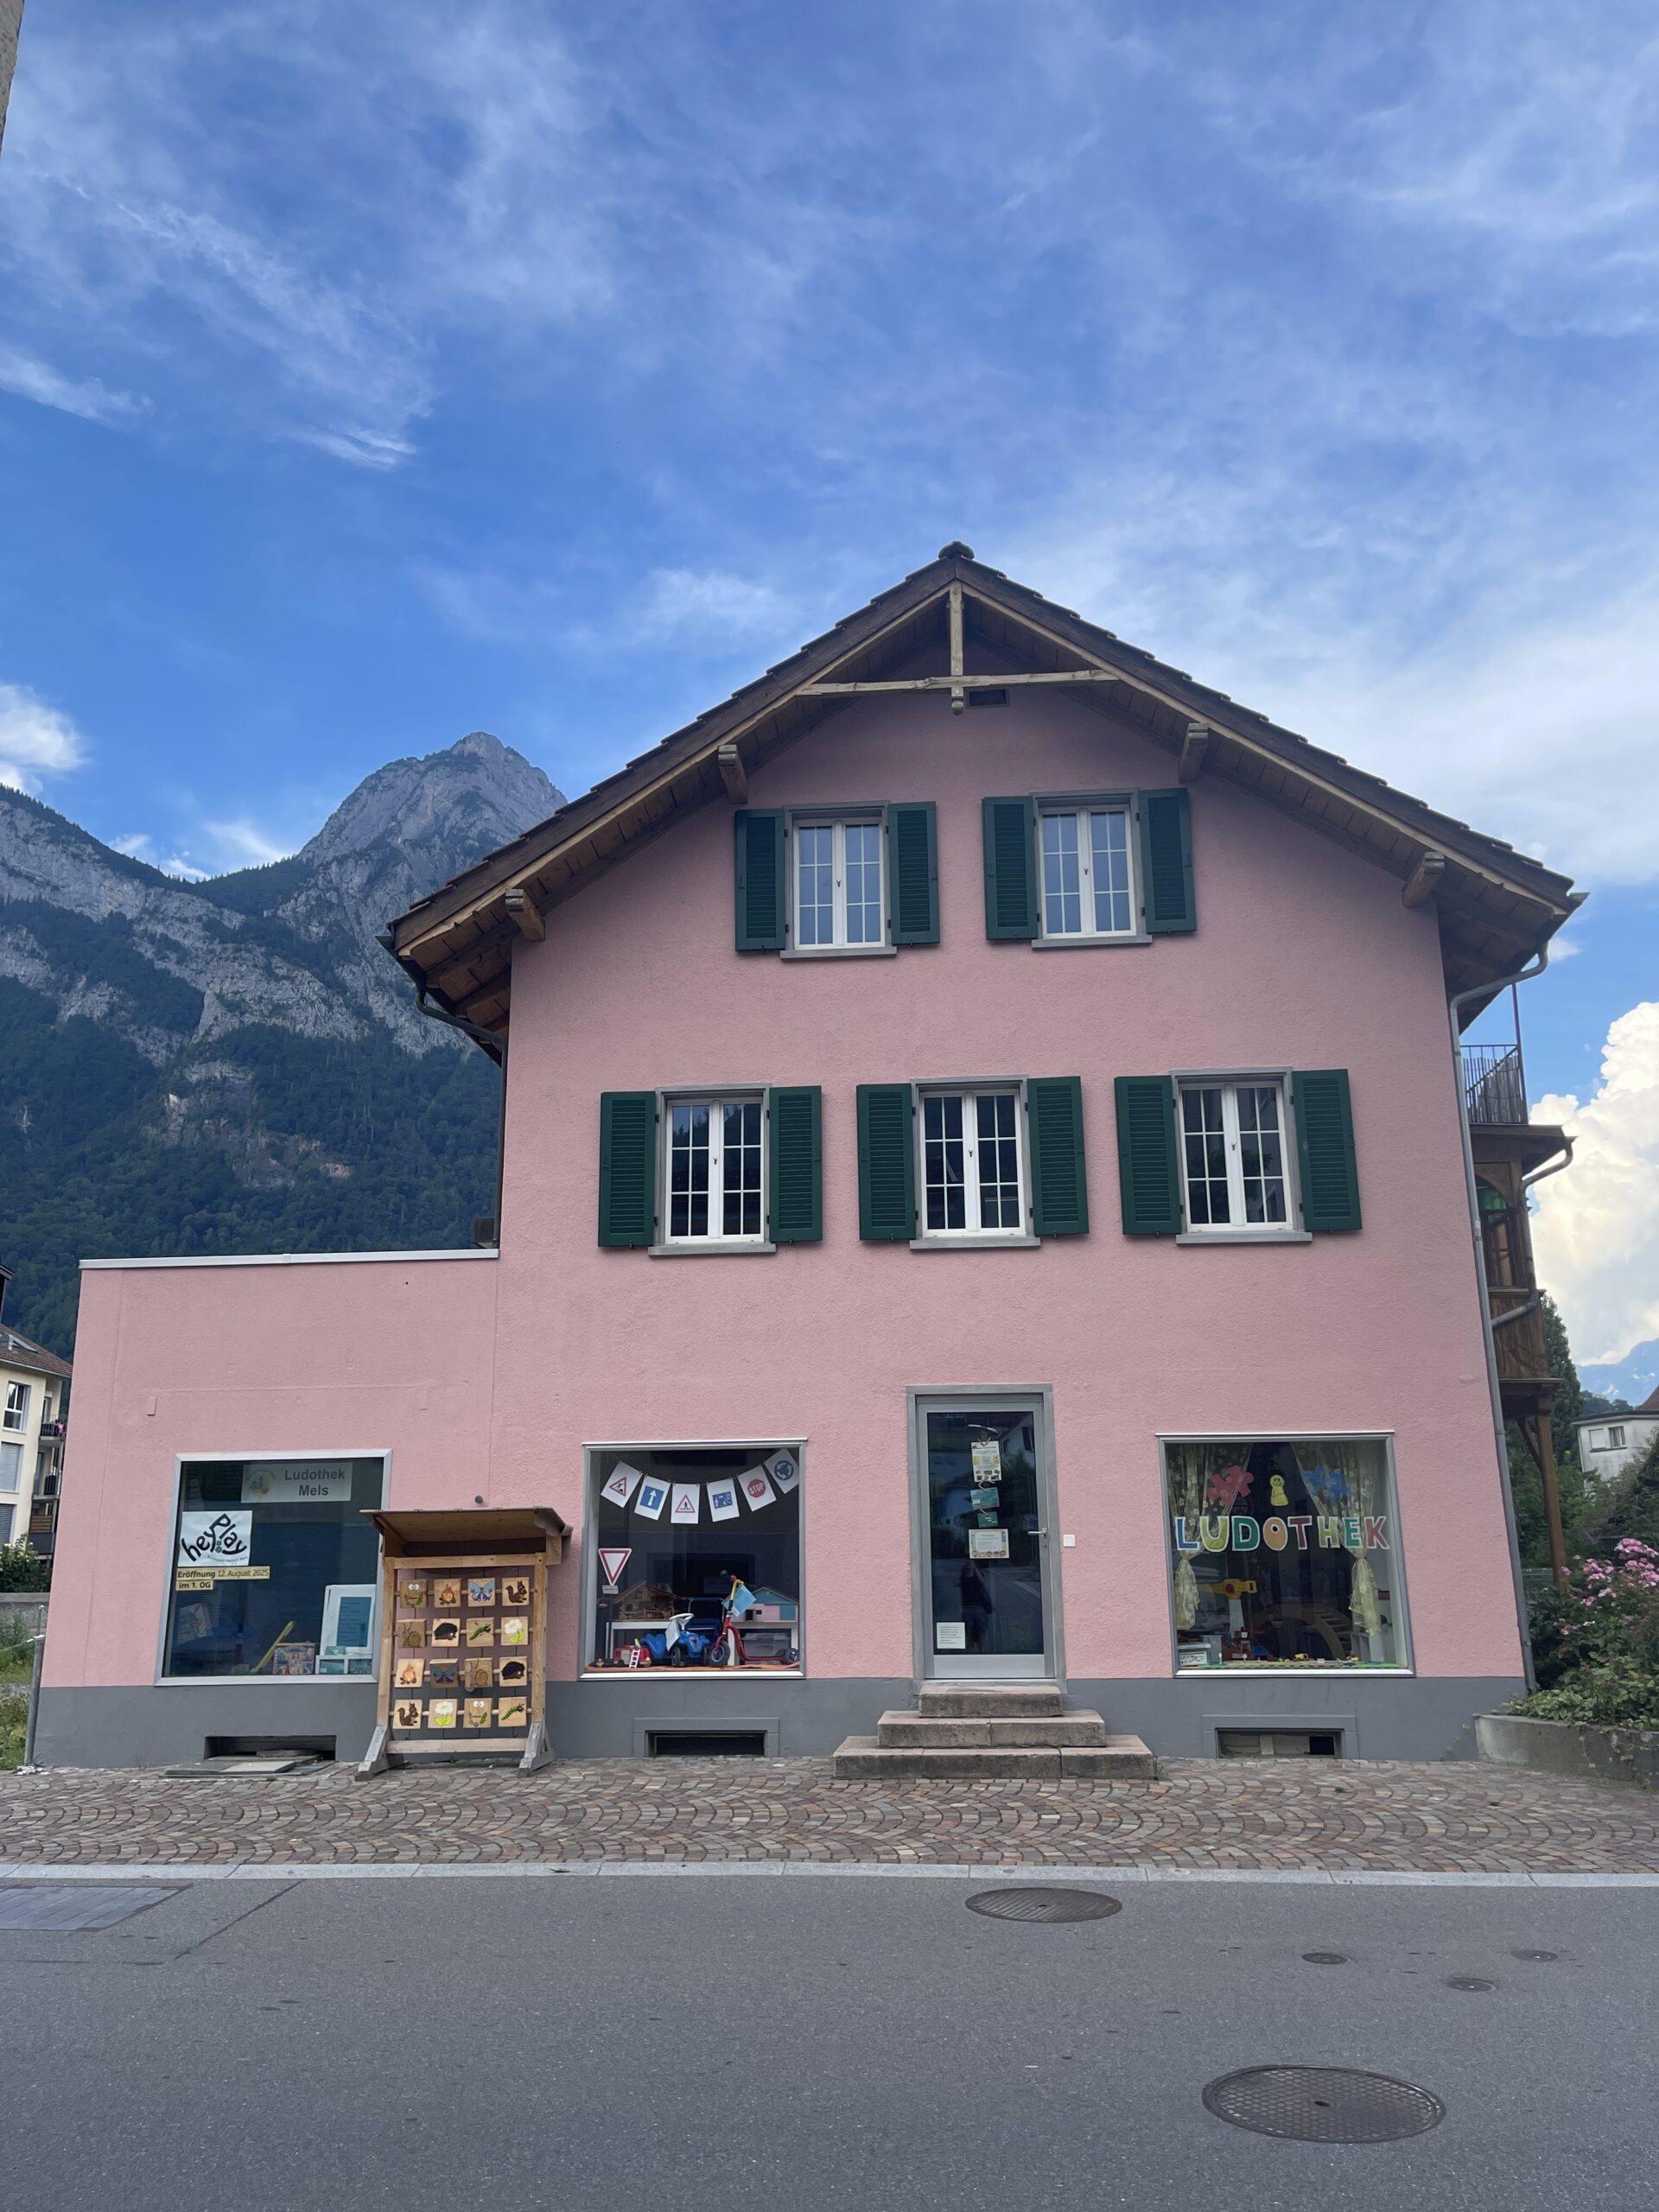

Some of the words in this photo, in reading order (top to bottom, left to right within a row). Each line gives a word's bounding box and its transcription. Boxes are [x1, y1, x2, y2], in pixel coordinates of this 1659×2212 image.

[284, 1469, 346, 1480] Ludothek
[298, 1484, 329, 1496] Mels
[748, 1482, 764, 1495] STOP
[1174, 1515, 1390, 1553] LUDOTHEK
[177, 1570, 216, 1580] Eröffnung
[227, 1569, 251, 1579] August
[252, 1568, 269, 1577] 2025
